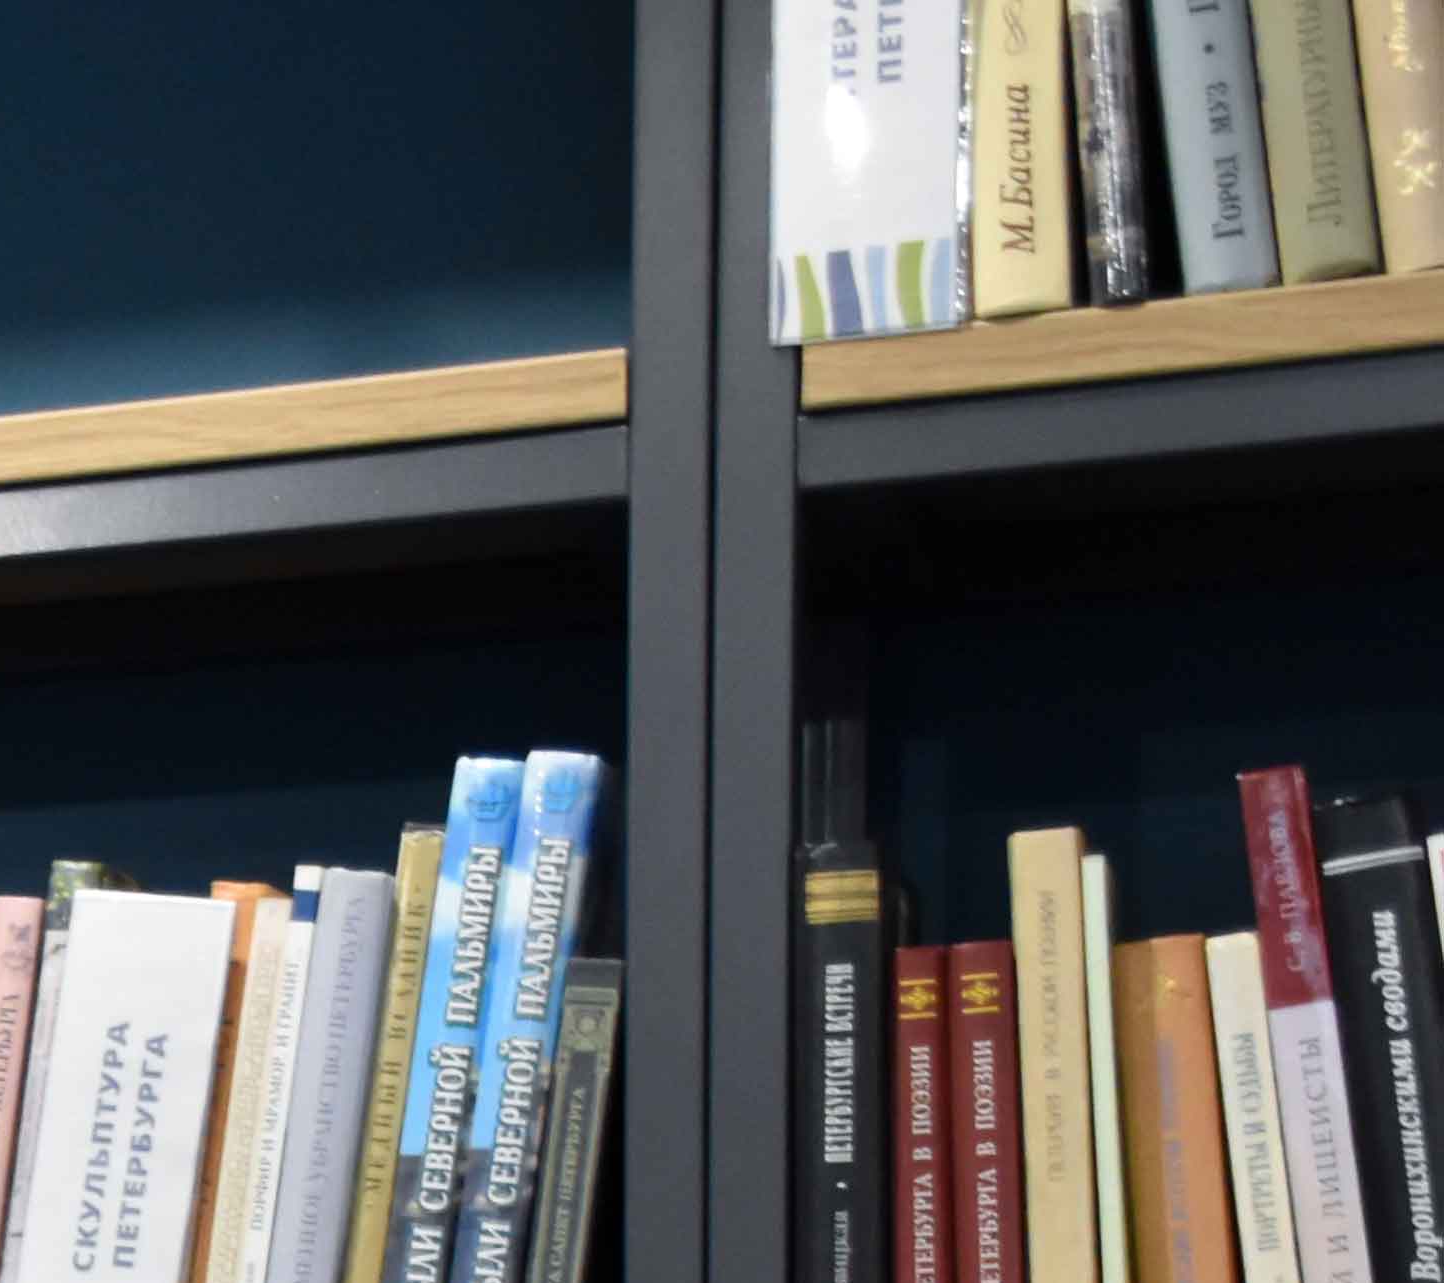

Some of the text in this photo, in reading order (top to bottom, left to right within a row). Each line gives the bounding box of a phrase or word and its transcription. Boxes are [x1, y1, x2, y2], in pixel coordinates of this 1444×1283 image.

[419, 1044, 472, 1211] СЕВЕРНОЙ
[446, 847, 502, 1025] ПАЛЬМИРЫ
[486, 1039, 541, 1206] СЕВЕРНОЙ
[514, 837, 570, 1016] ПАЛЬМИРЫ
[1370, 911, 1408, 1032] сводами
[72, 1022, 130, 1272] СКУЛЬПТУРА
[112, 1033, 169, 1269] ПЕТЕРБУРГА
[910, 1045, 933, 1135] ПОЭЗИИ
[973, 1040, 998, 1129] ПОЭЗИИ
[977, 1142, 998, 1154] В
[1297, 1036, 1345, 1219] ЛИЦЕИСТЫ
[1385, 1039, 1442, 1281] Воронихинскими
[1324, 1234, 1348, 1253] И
